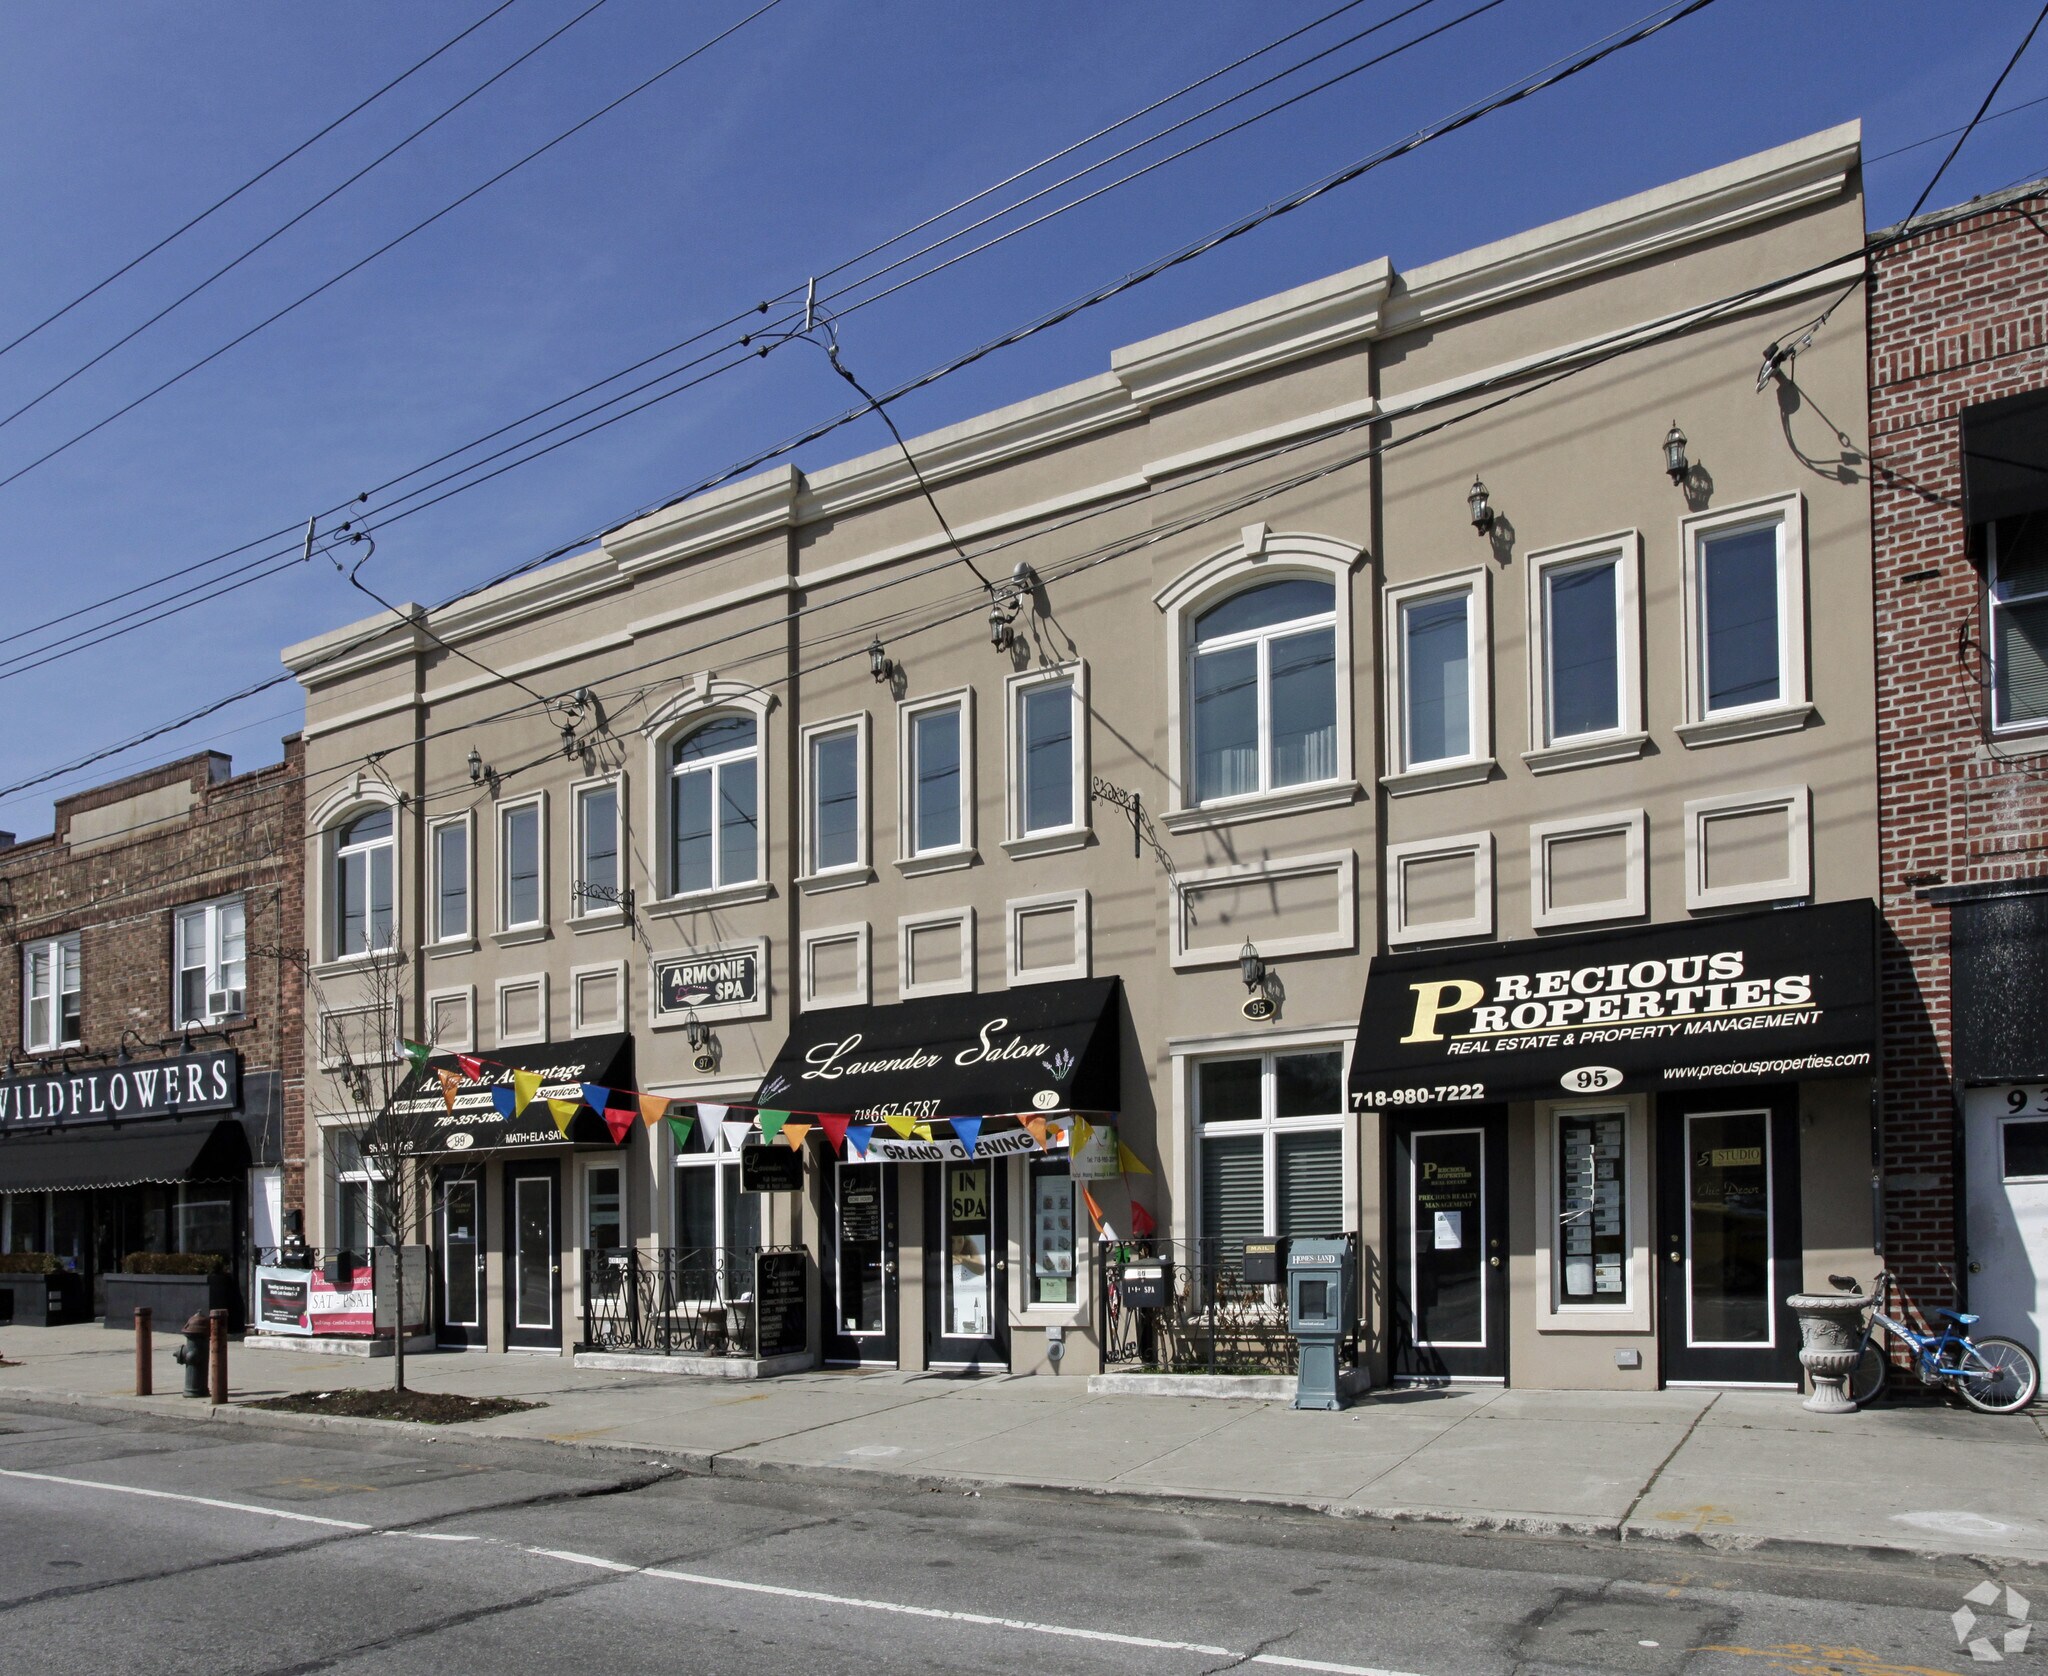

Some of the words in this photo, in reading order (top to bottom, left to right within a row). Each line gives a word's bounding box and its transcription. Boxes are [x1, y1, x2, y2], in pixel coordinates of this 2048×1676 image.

[671, 960, 744, 987] ARMONIE
[715, 981, 744, 1000] SPA
[1252, 1002, 1265, 1015] 95
[1447, 1039, 1493, 1056] REAL
[1495, 1033, 1561, 1052] ESTATE
[1563, 1032, 1574, 1046] &
[1580, 1024, 1680, 1045] PROPERTY
[1683, 1010, 1824, 1035] MANAGEMENT
[801, 1033, 942, 1080] Lavender
[955, 1018, 1051, 1066] Salon
[1663, 1051, 1870, 1080] www.preciousproperties.com
[418, 1070, 494, 1093] Acemic
[494, 1064, 585, 1085] Antage
[1576, 1070, 1609, 1089] 95
[456, 1095, 477, 1108] Prep
[538, 1087, 579, 1099] Services
[1038, 1092, 1055, 1108] 97
[1351, 1083, 1485, 1108] 718-980-7222
[855, 1109, 870, 1120] 718
[871, 1099, 941, 1122] 667-6787
[883, 1144, 944, 1160] GRAND
[950, 1133, 1034, 1158] OENING
[1718, 1149, 1760, 1160] STUDIO
[959, 1172, 976, 1192] IN
[1418, 1193, 1450, 1201] PRECIOUS
[1452, 1192, 1478, 1200] REALTY
[952, 1198, 986, 1218] SPA
[1144, 1286, 1155, 1294] SPA
[313, 1295, 333, 1309] SAT
[344, 1293, 371, 1308] PSAT
